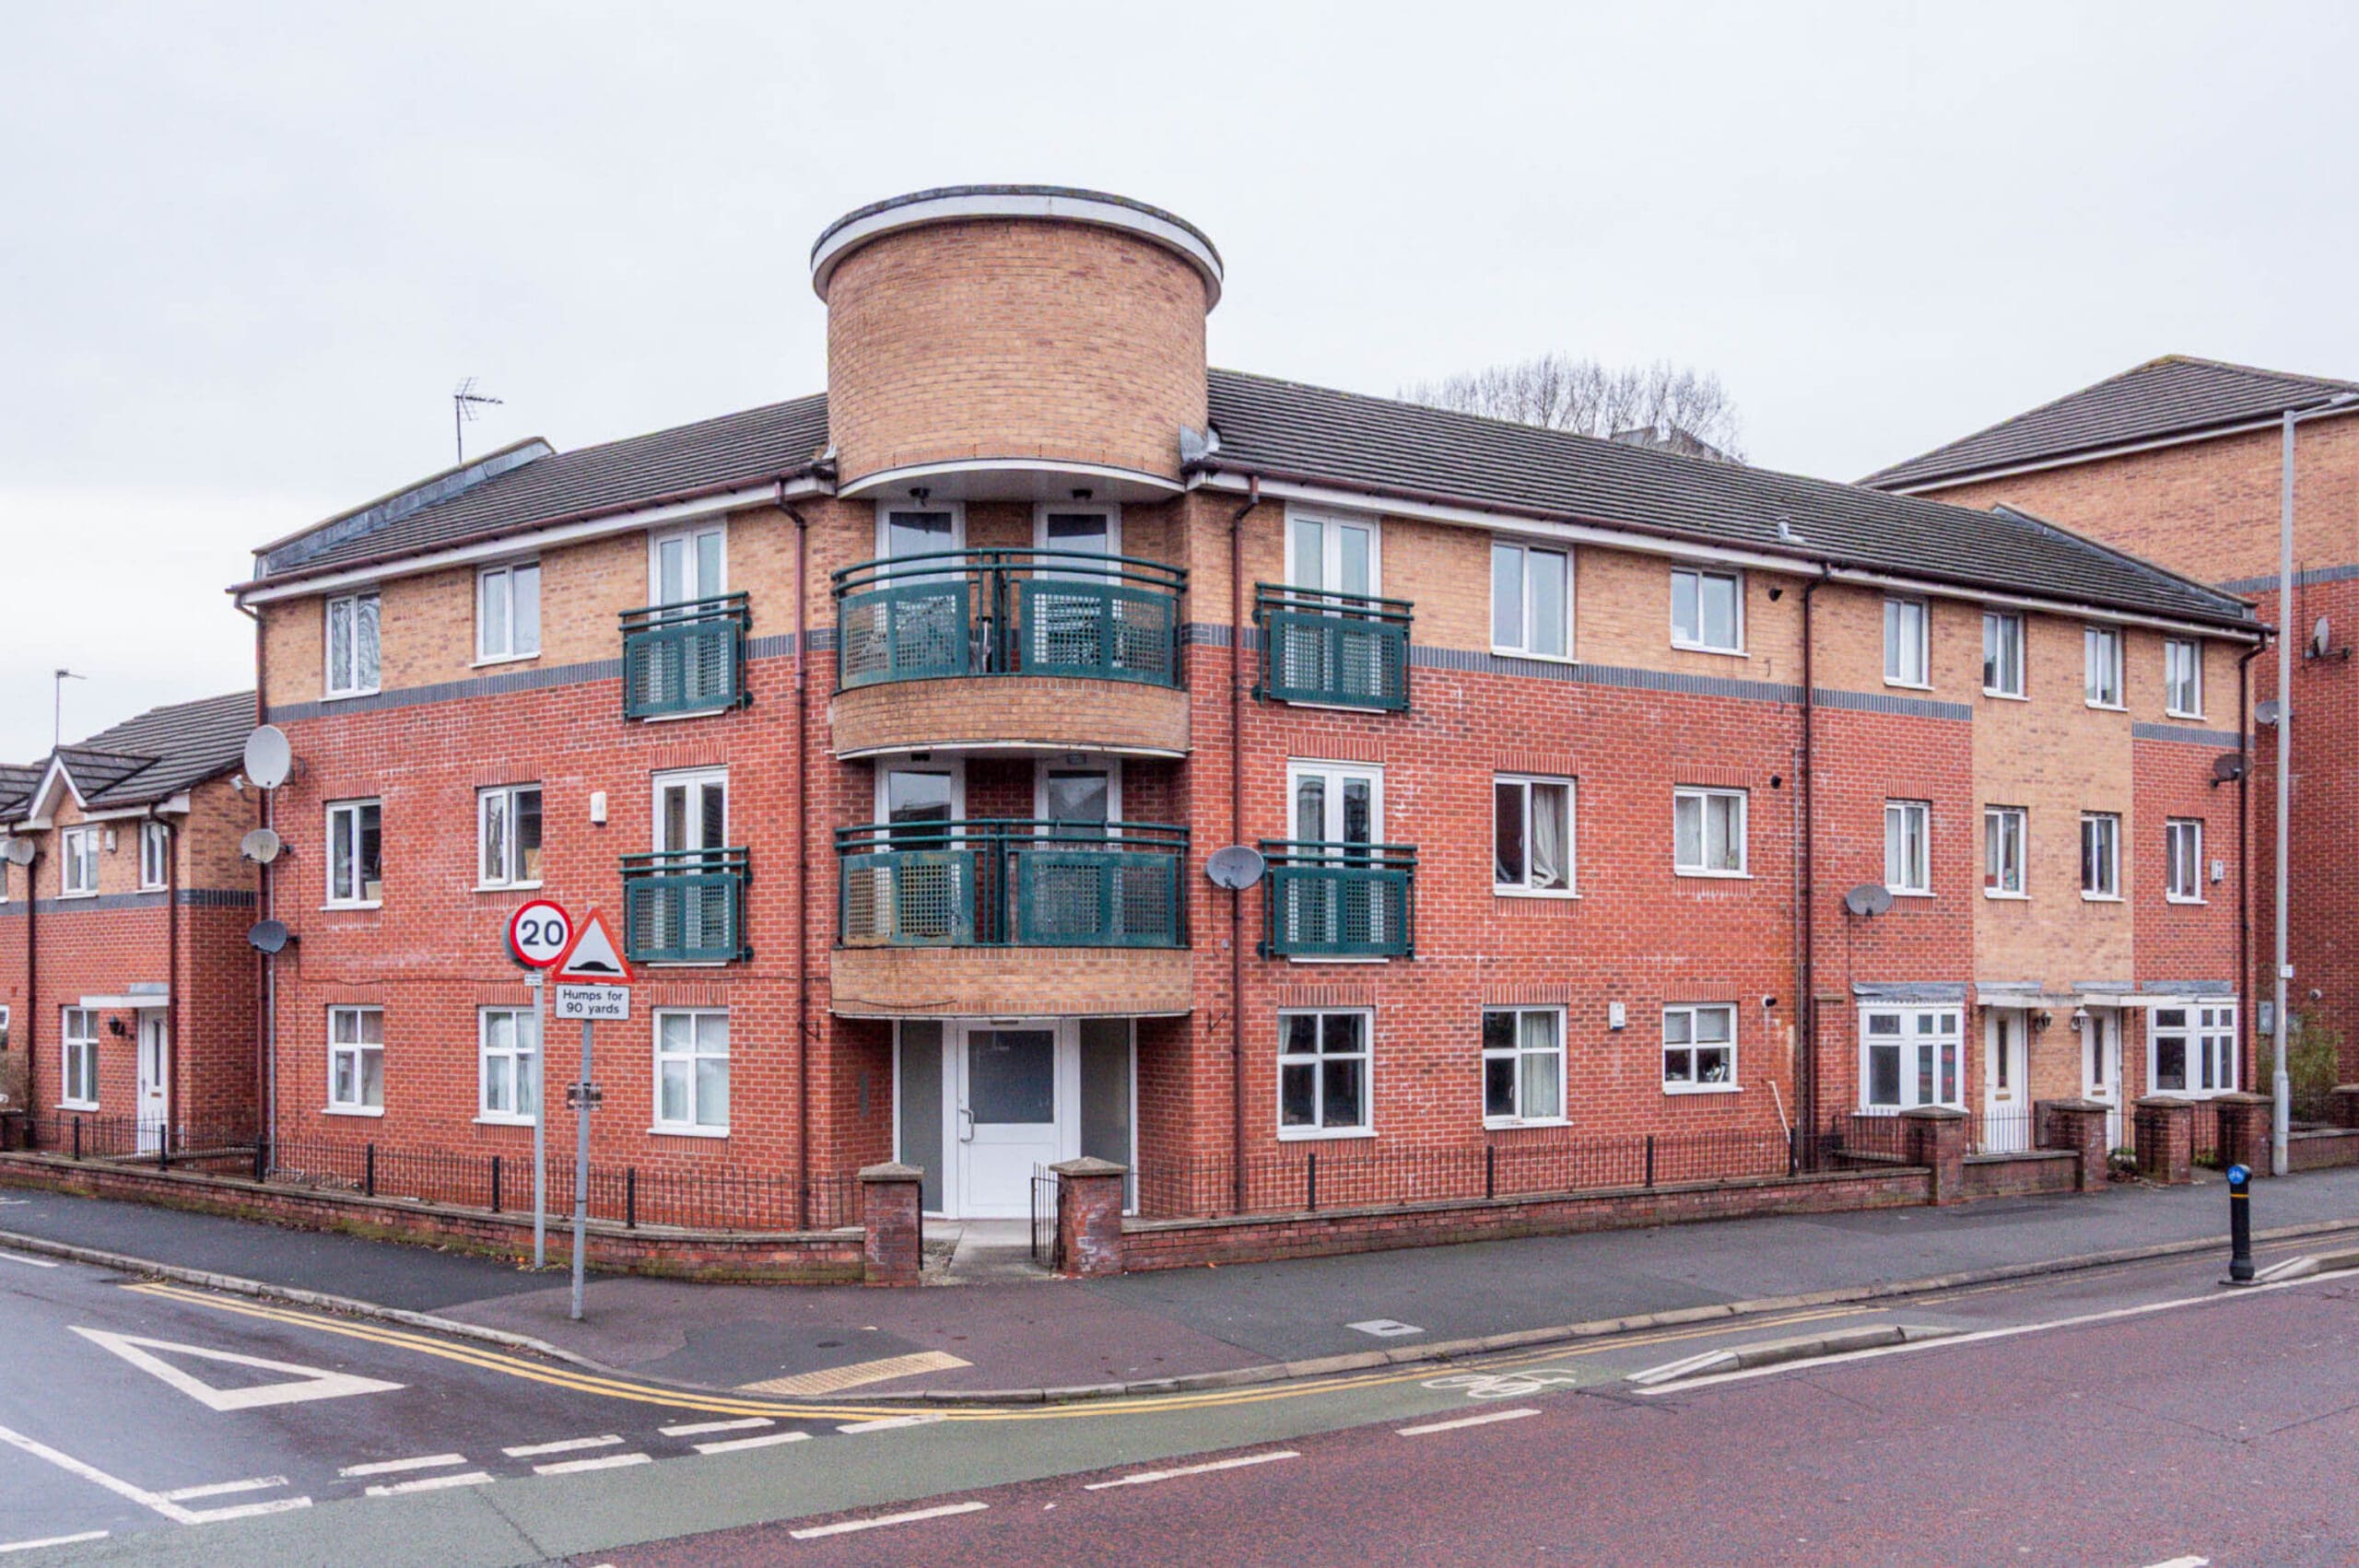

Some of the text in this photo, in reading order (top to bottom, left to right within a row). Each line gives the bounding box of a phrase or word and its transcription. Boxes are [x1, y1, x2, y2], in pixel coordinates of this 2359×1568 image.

[521, 919, 564, 946] 20
[563, 989, 623, 1002] Humps for
[566, 1001, 620, 1015] 90 yards
